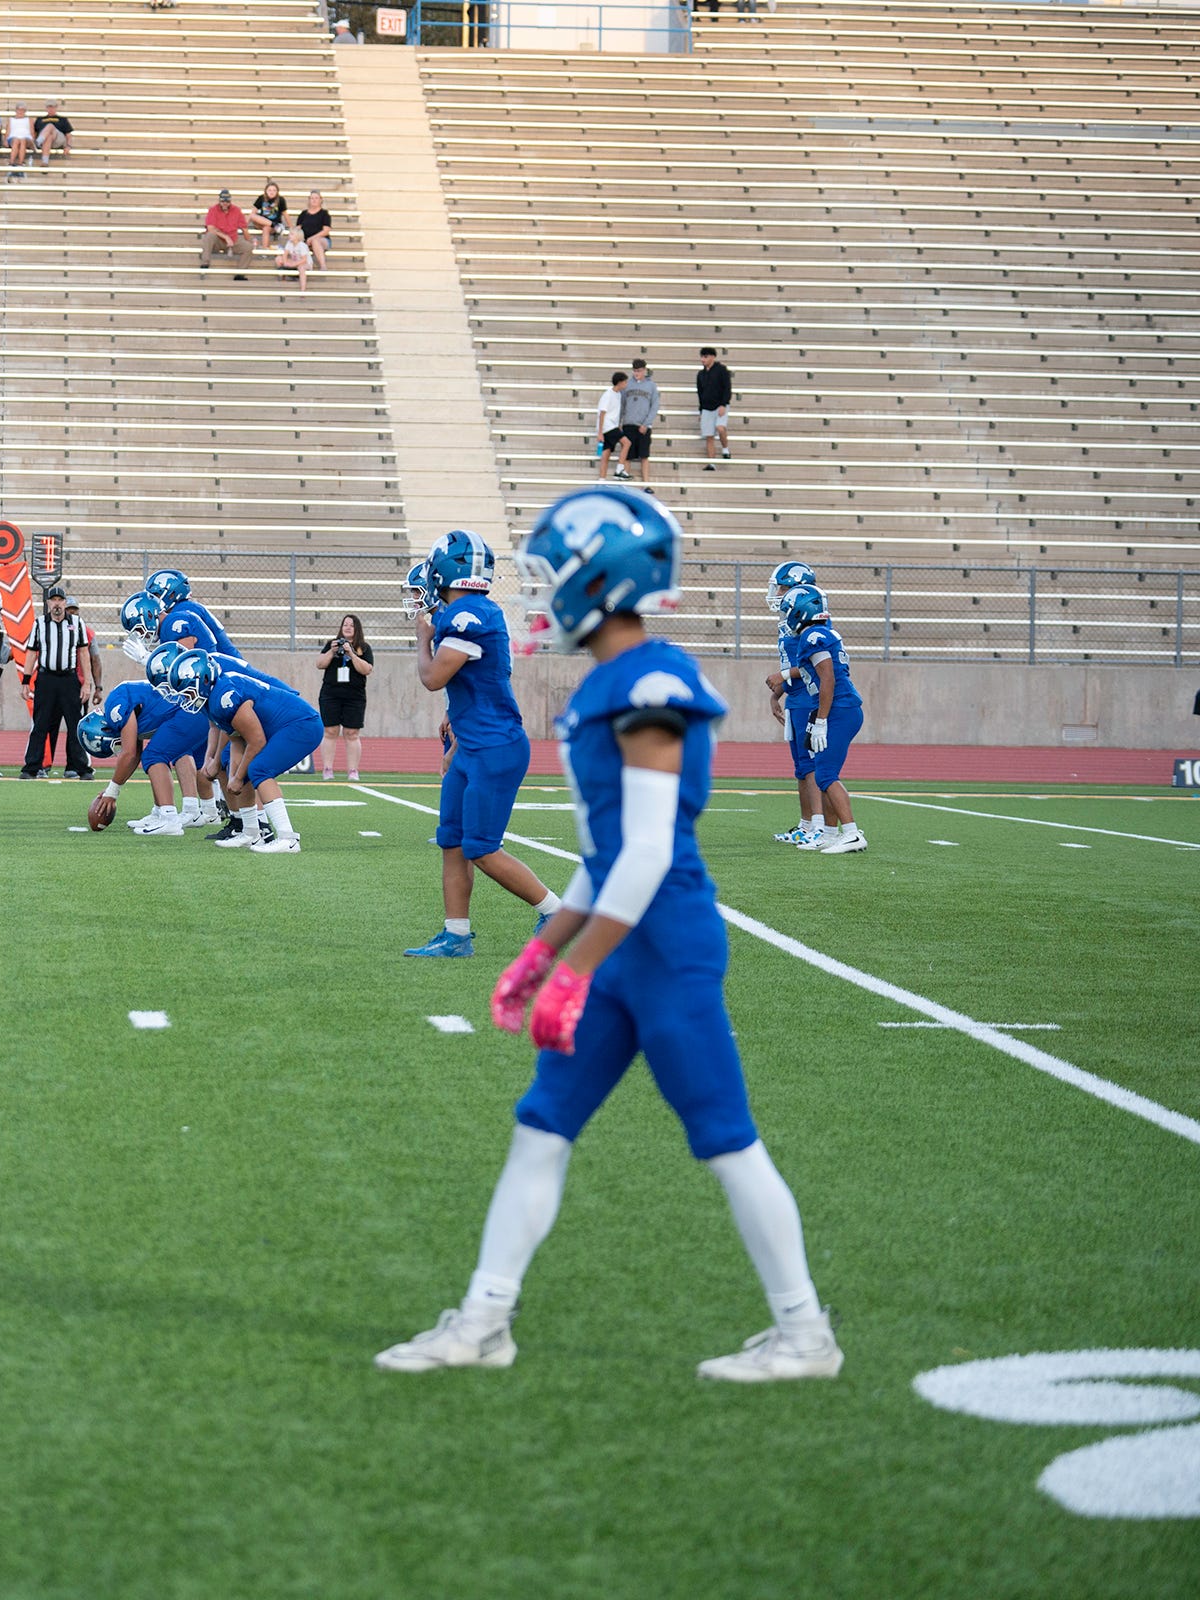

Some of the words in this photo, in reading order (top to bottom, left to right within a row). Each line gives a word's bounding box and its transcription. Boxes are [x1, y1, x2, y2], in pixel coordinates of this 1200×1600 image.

[381, 17, 402, 31] EXIT
[41, 536, 55, 572] 1
[461, 580, 488, 589] Riddell
